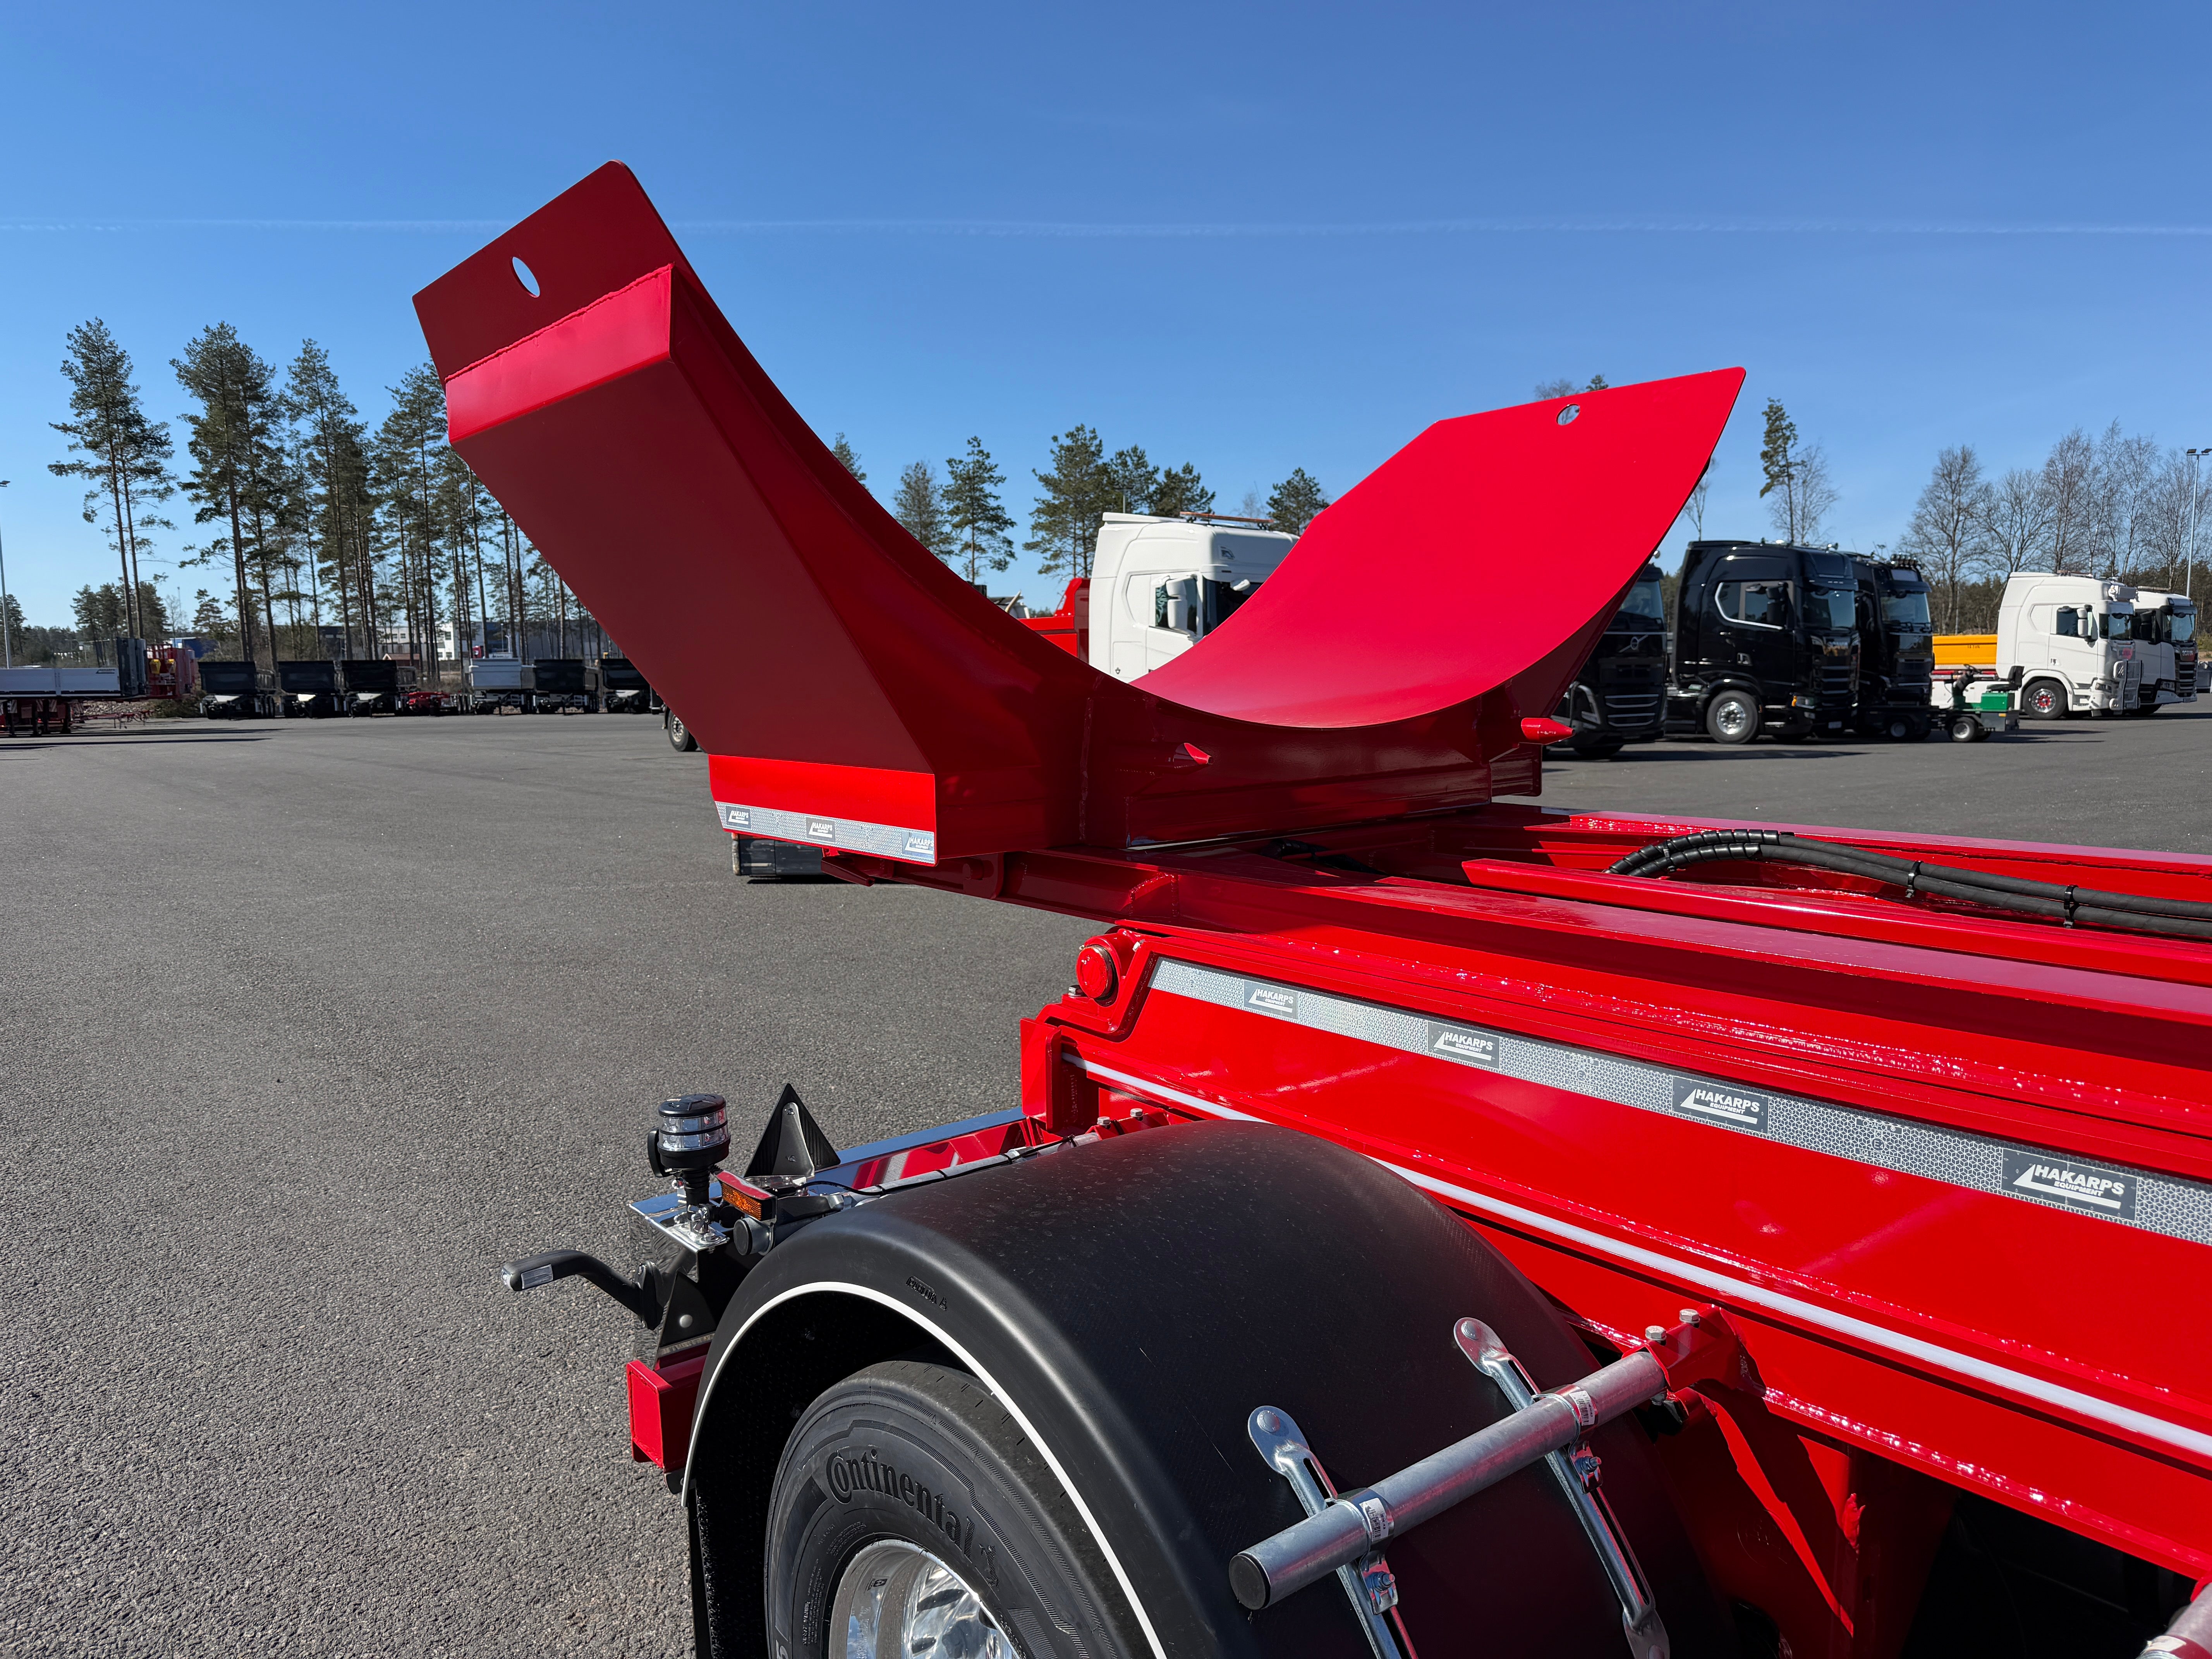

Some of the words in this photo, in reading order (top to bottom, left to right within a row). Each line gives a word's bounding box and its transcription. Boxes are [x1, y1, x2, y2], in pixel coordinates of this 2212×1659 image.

[813, 822, 833, 831] HAKARPS
[1257, 989, 1294, 1004] HAKARPS
[1445, 1032, 1494, 1051] HAKARPS
[1455, 1043, 1482, 1053] EQUIPMENT
[1695, 1089, 1760, 1112] HAKARPS
[1710, 1102, 1745, 1115] EQUIPMENT
[2034, 1164, 2125, 1195] HAKARPS
[2054, 1181, 2104, 1197] EQUIPMENT
[826, 1449, 975, 1559] Continental
